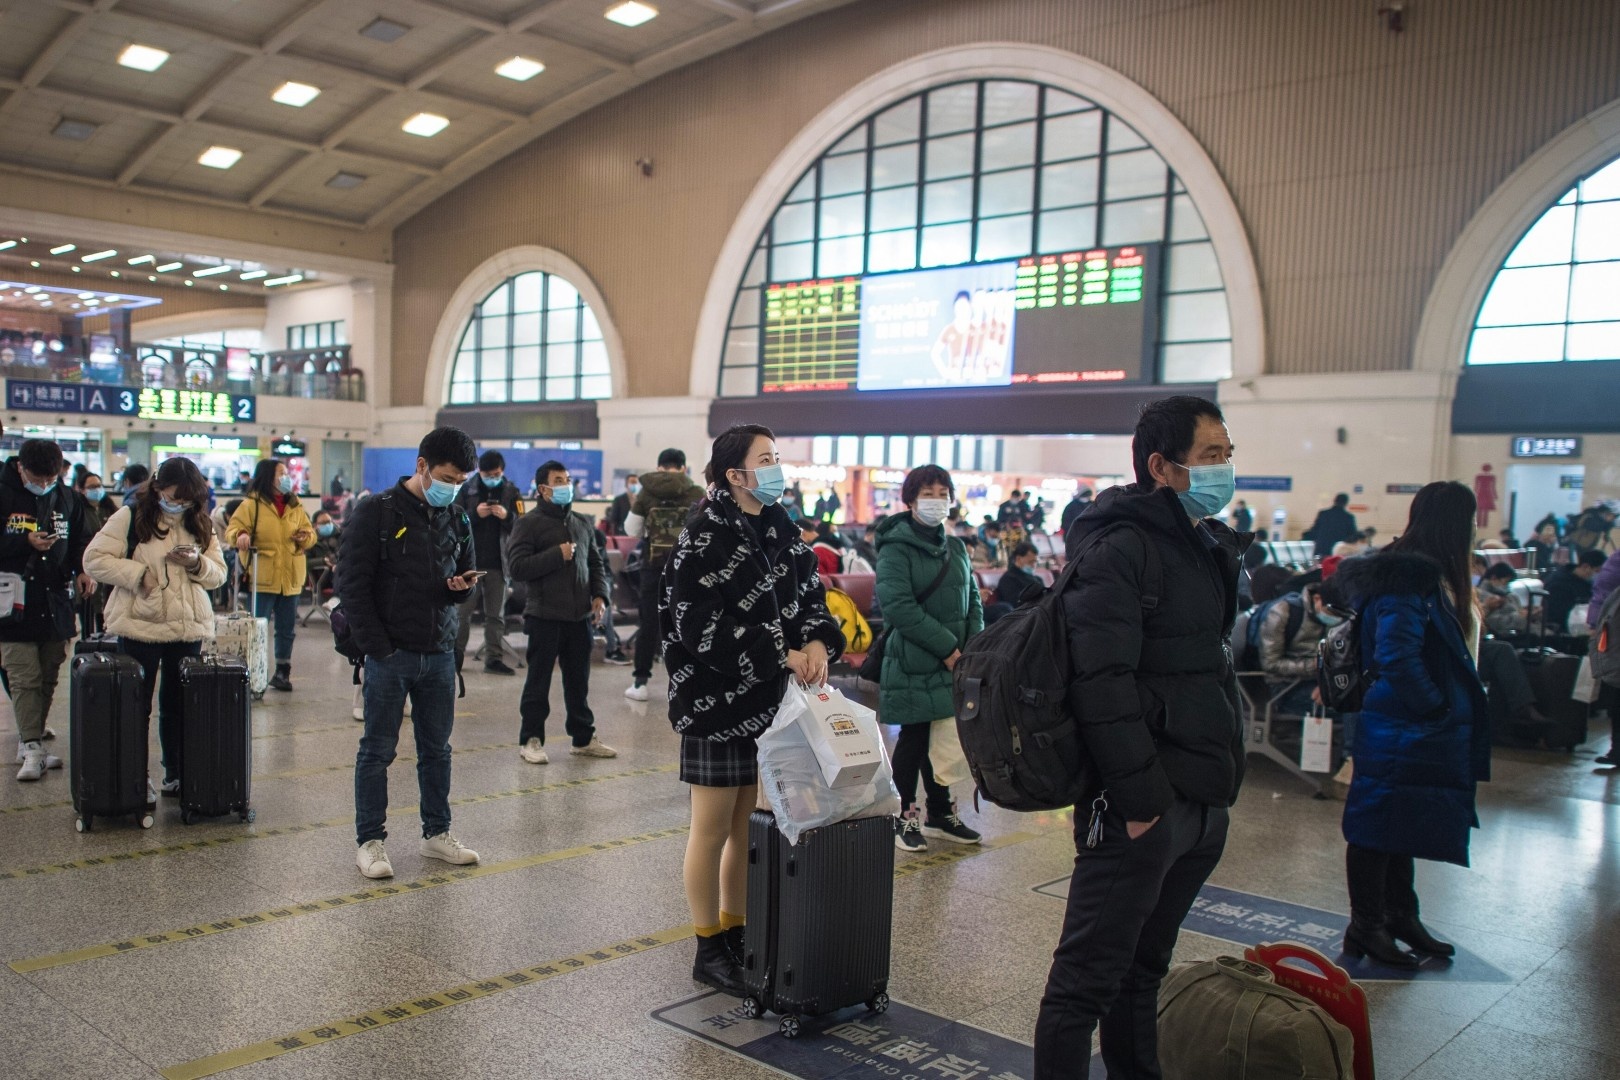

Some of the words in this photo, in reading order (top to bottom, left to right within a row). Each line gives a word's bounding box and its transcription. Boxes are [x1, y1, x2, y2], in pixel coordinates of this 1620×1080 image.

[35, 385, 76, 402] 检票口
[89, 390, 107, 411] A
[119, 391, 134, 412] 3
[238, 399, 252, 419] 2
[822, 1044, 901, 1075] Channel
